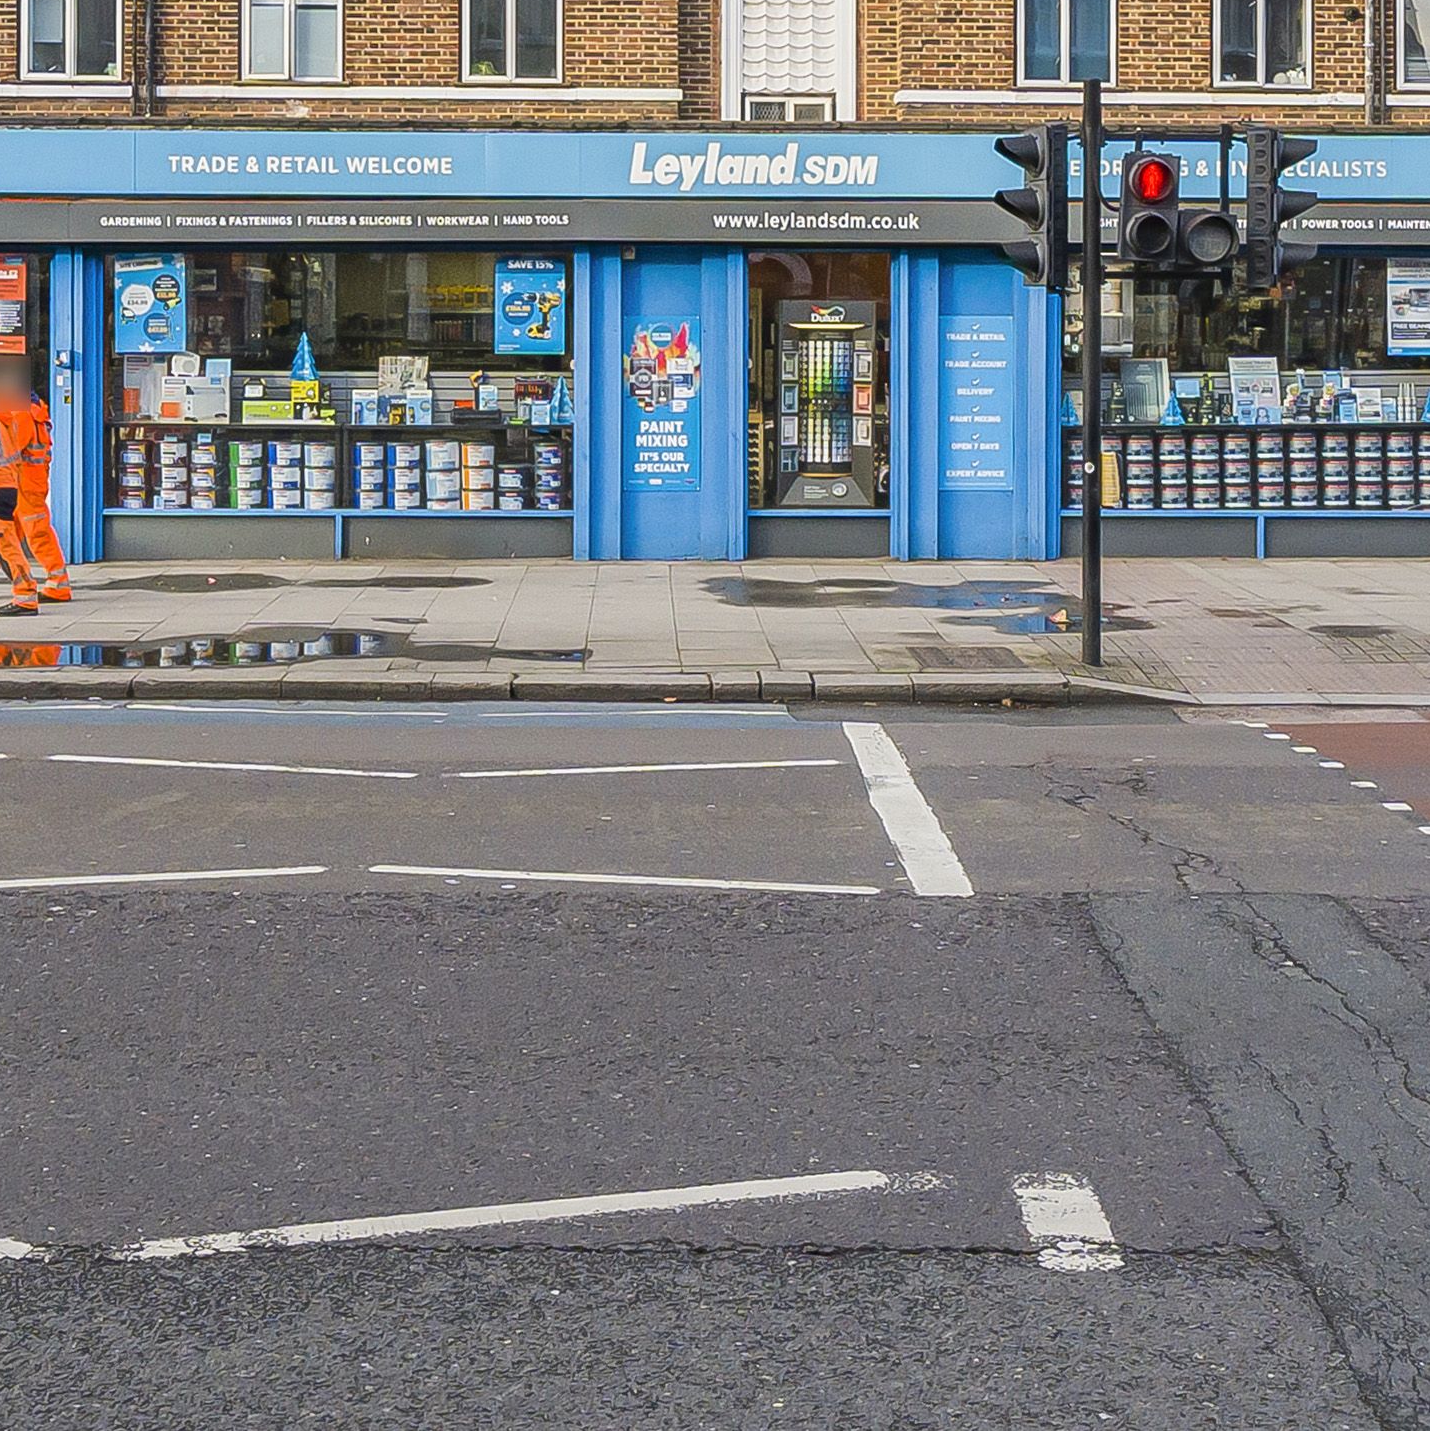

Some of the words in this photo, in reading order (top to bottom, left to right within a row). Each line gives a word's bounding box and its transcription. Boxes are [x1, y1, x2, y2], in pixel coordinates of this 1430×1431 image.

[168, 155, 239, 174] TRADE
[245, 156, 260, 174] &
[266, 156, 340, 174] RETAIL
[346, 156, 453, 175] WELCOME
[629, 142, 798, 191] Leyland
[802, 155, 878, 185] SDM
[1195, 159, 1210, 178] &
[1282, 159, 1388, 179] ECIALISTS
[99, 215, 162, 227] GARDENING
[175, 215, 217, 227] FIXINGS
[228, 215, 293, 227] FASTENINGS
[306, 215, 348, 227] FILLERS
[359, 215, 413, 227] SILICONES
[426, 215, 490, 227] WORKWEAR
[502, 214, 533, 226] HAND
[535, 214, 570, 226] TOOLS
[712, 212, 921, 231] www.leylandsdm.co.uk
[1301, 218, 1339, 230] POWER
[1341, 218, 1374, 230] TOOLS
[507, 260, 533, 269] SAVE
[640, 421, 684, 434] PAINT
[636, 435, 688, 447] MIXING
[639, 452, 659, 461] IT'S
[661, 452, 684, 461] OUR
[634, 463, 690, 473] SPECIALTY
